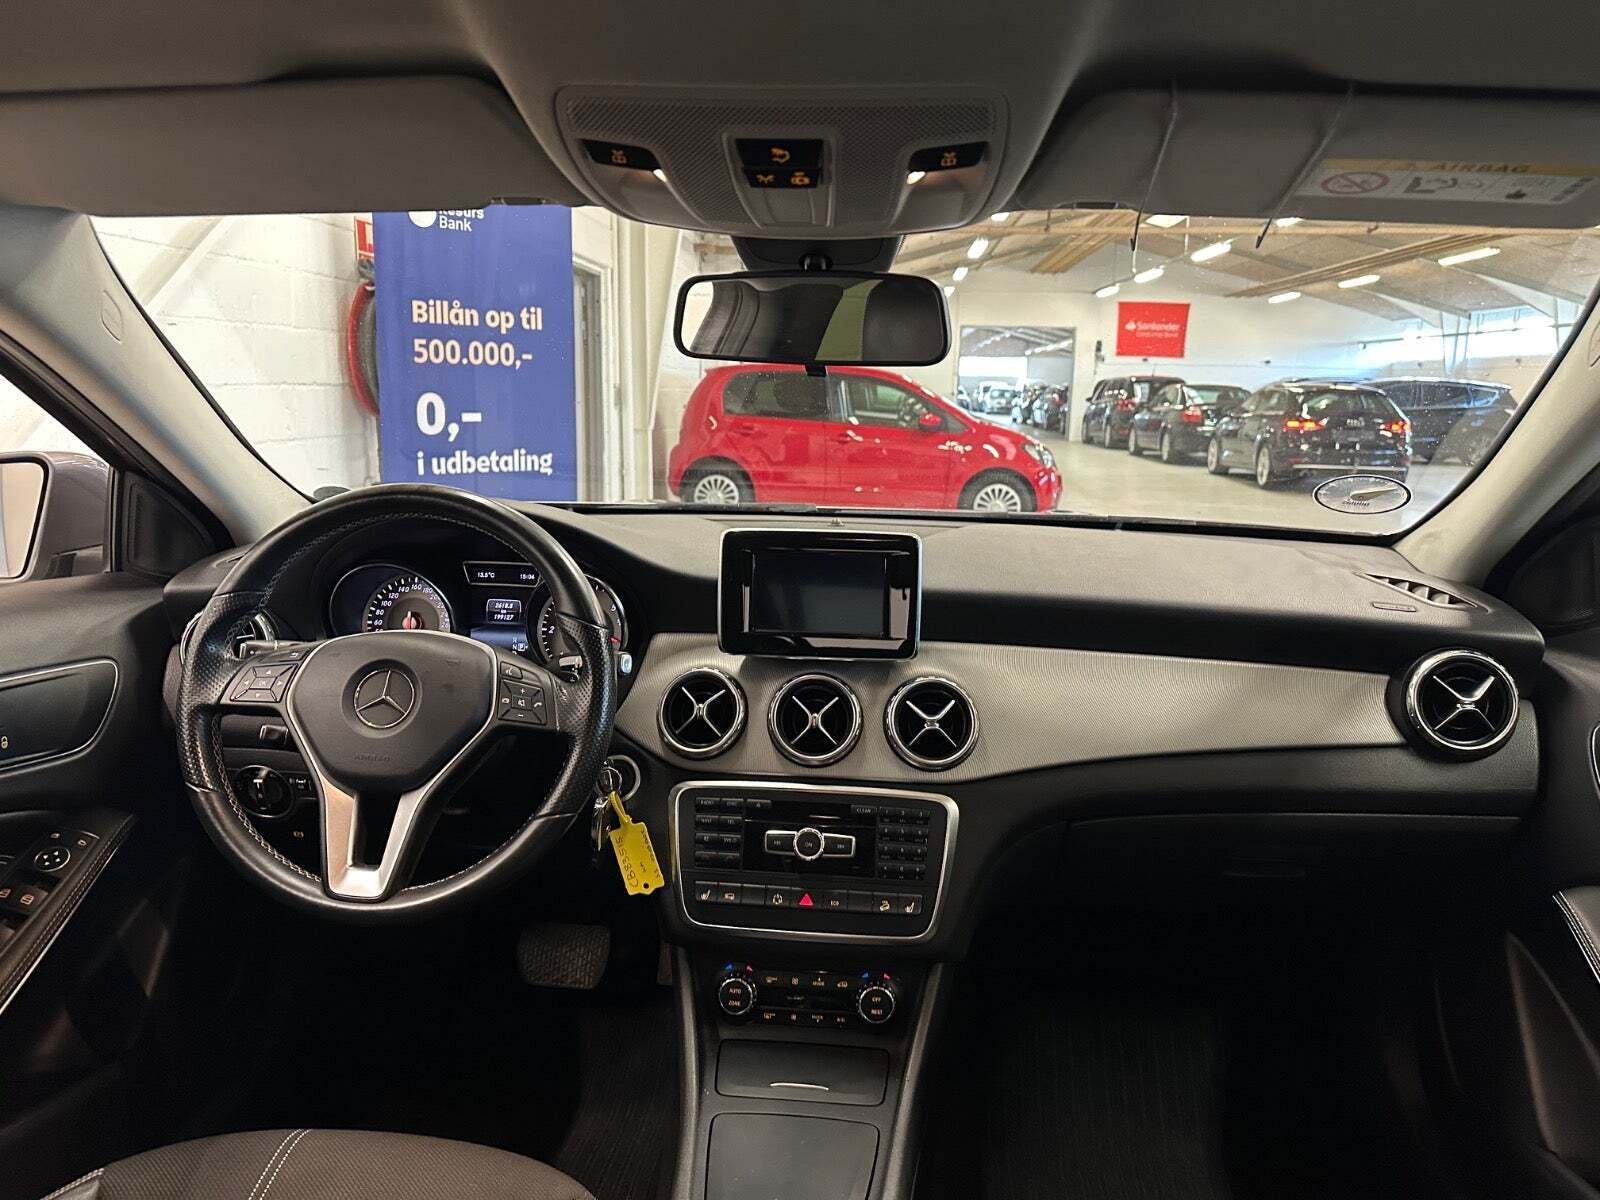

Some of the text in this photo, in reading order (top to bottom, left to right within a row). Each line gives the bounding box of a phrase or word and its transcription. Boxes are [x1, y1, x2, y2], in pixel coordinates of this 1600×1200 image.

[439, 215, 472, 232] Bank
[411, 300, 543, 334] Billån op til
[413, 339, 533, 370] 500.000,-
[416, 392, 482, 442] 0,-
[417, 449, 553, 476] i udbetaling
[548, 625, 555, 634] 2
